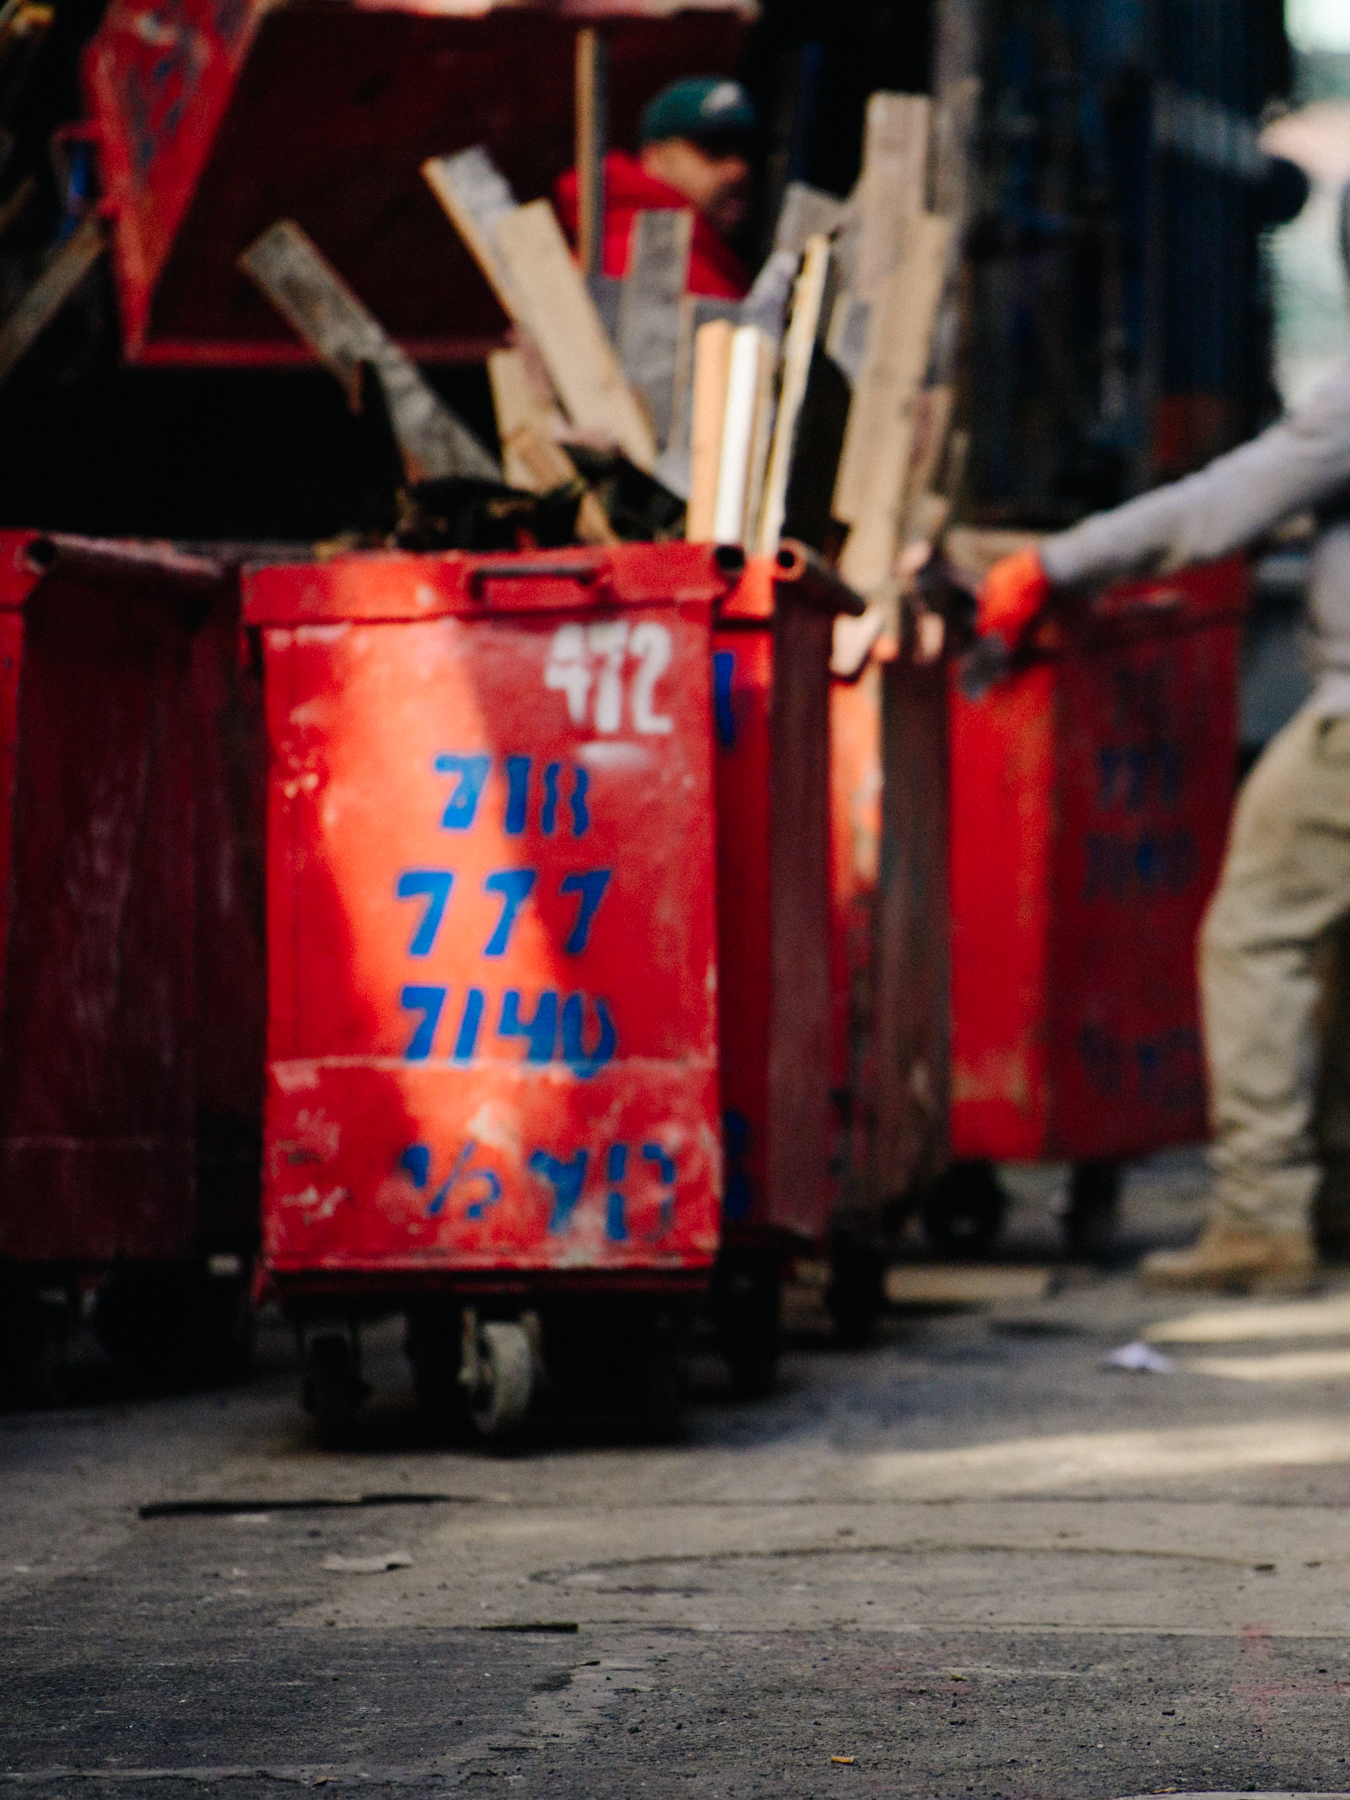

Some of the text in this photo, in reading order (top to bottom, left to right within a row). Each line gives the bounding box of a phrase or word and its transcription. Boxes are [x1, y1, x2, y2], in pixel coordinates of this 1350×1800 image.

[545, 621, 673, 734] 472
[433, 755, 591, 838] 718
[397, 869, 611, 956] 777
[401, 985, 615, 1079] 7140
